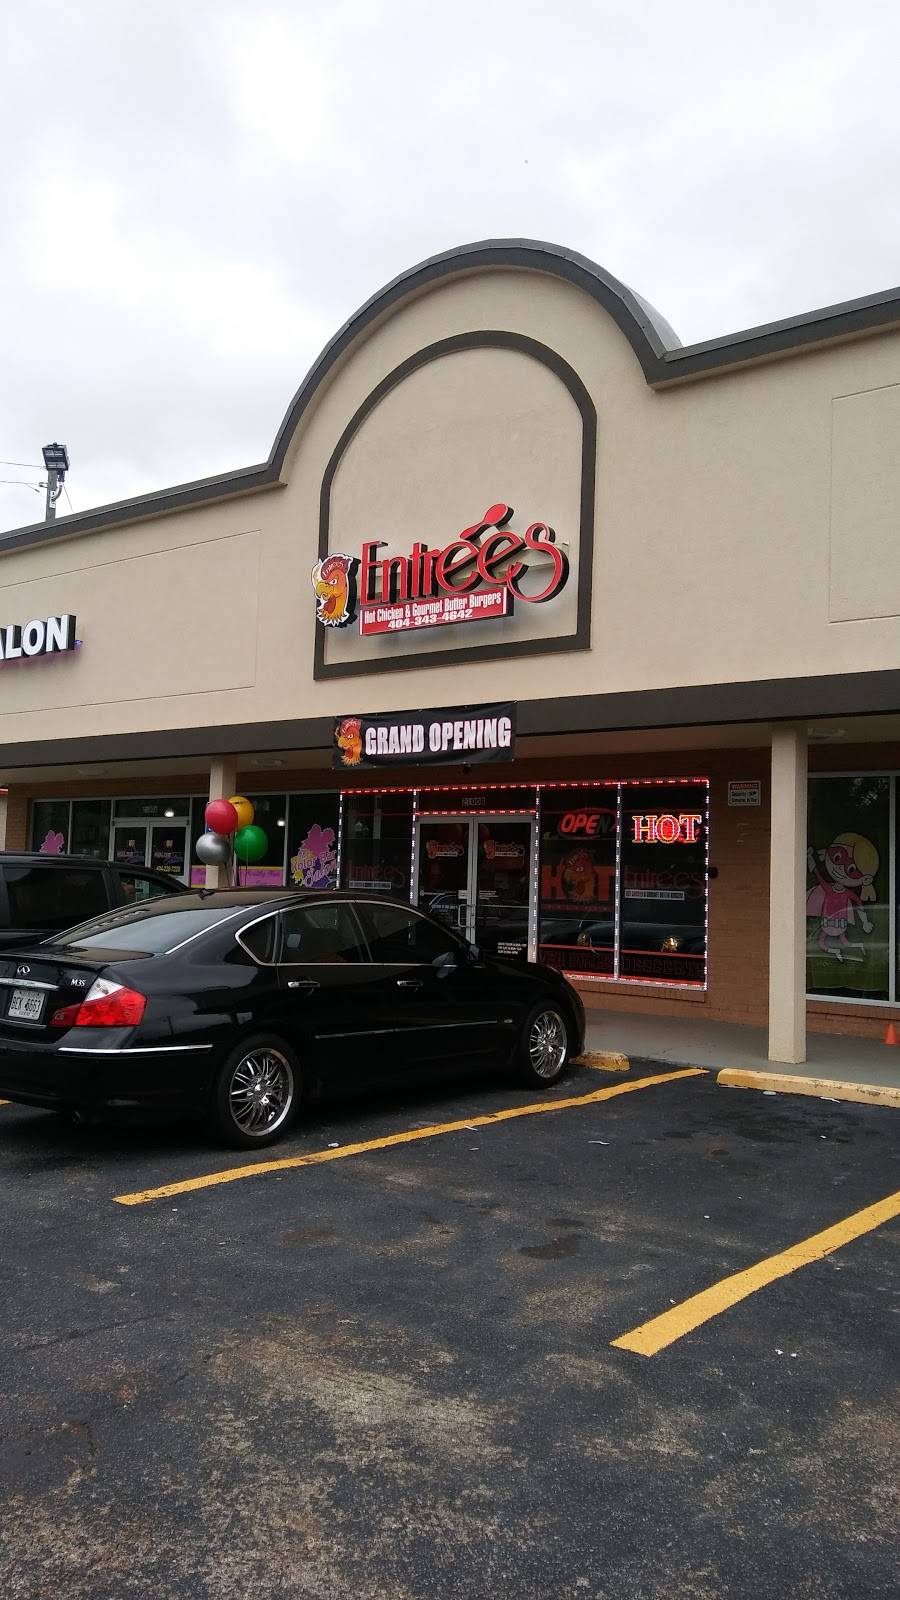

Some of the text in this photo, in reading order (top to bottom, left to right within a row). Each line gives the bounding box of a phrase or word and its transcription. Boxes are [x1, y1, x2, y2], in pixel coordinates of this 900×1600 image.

[364, 592, 502, 624] Hot Chicken & Gourmet Butter Burgers
[387, 608, 473, 629] 404-343-4642
[365, 724, 425, 756] GRAND
[428, 717, 512, 752] OPENING
[560, 813, 612, 834] OPEN
[631, 814, 702, 844] HOT
